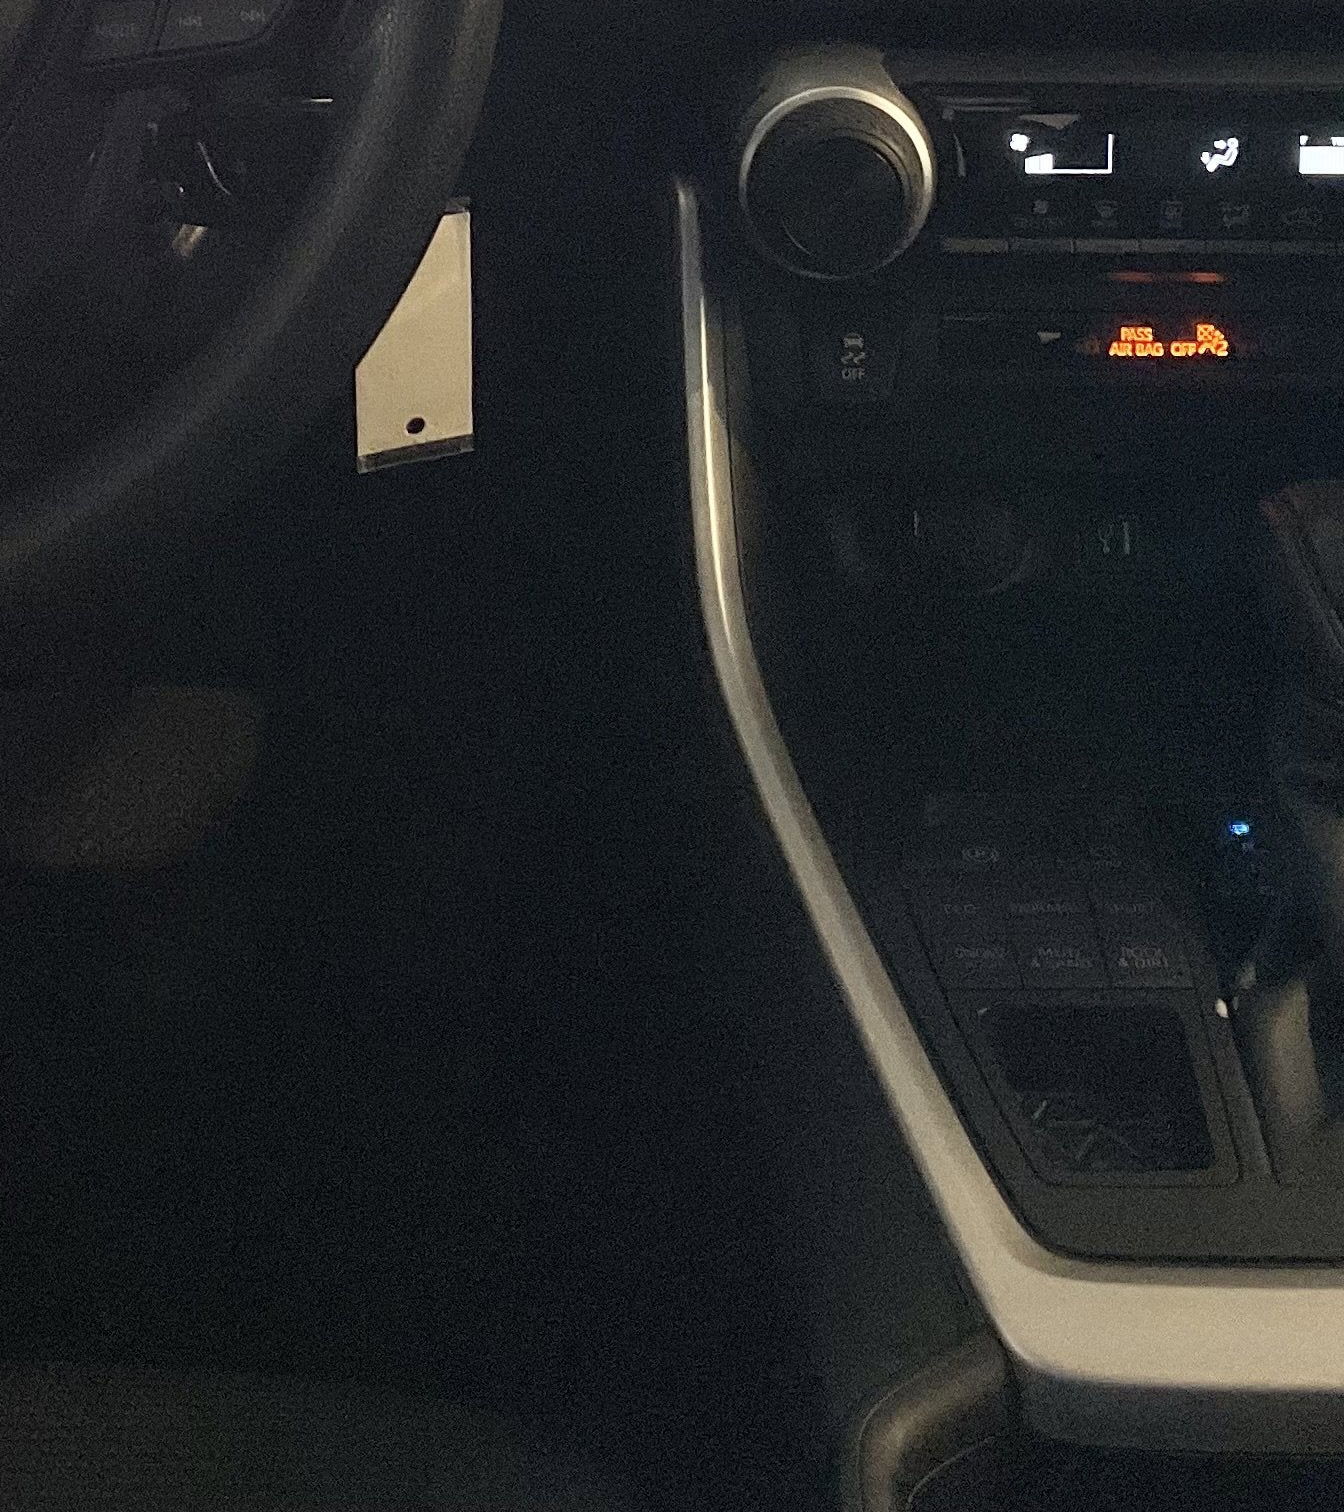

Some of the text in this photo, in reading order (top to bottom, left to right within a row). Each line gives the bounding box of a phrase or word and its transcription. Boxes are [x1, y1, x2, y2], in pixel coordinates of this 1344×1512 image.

[1120, 326, 1154, 341] PASS
[1109, 342, 1197, 357] AIR BAG OFF
